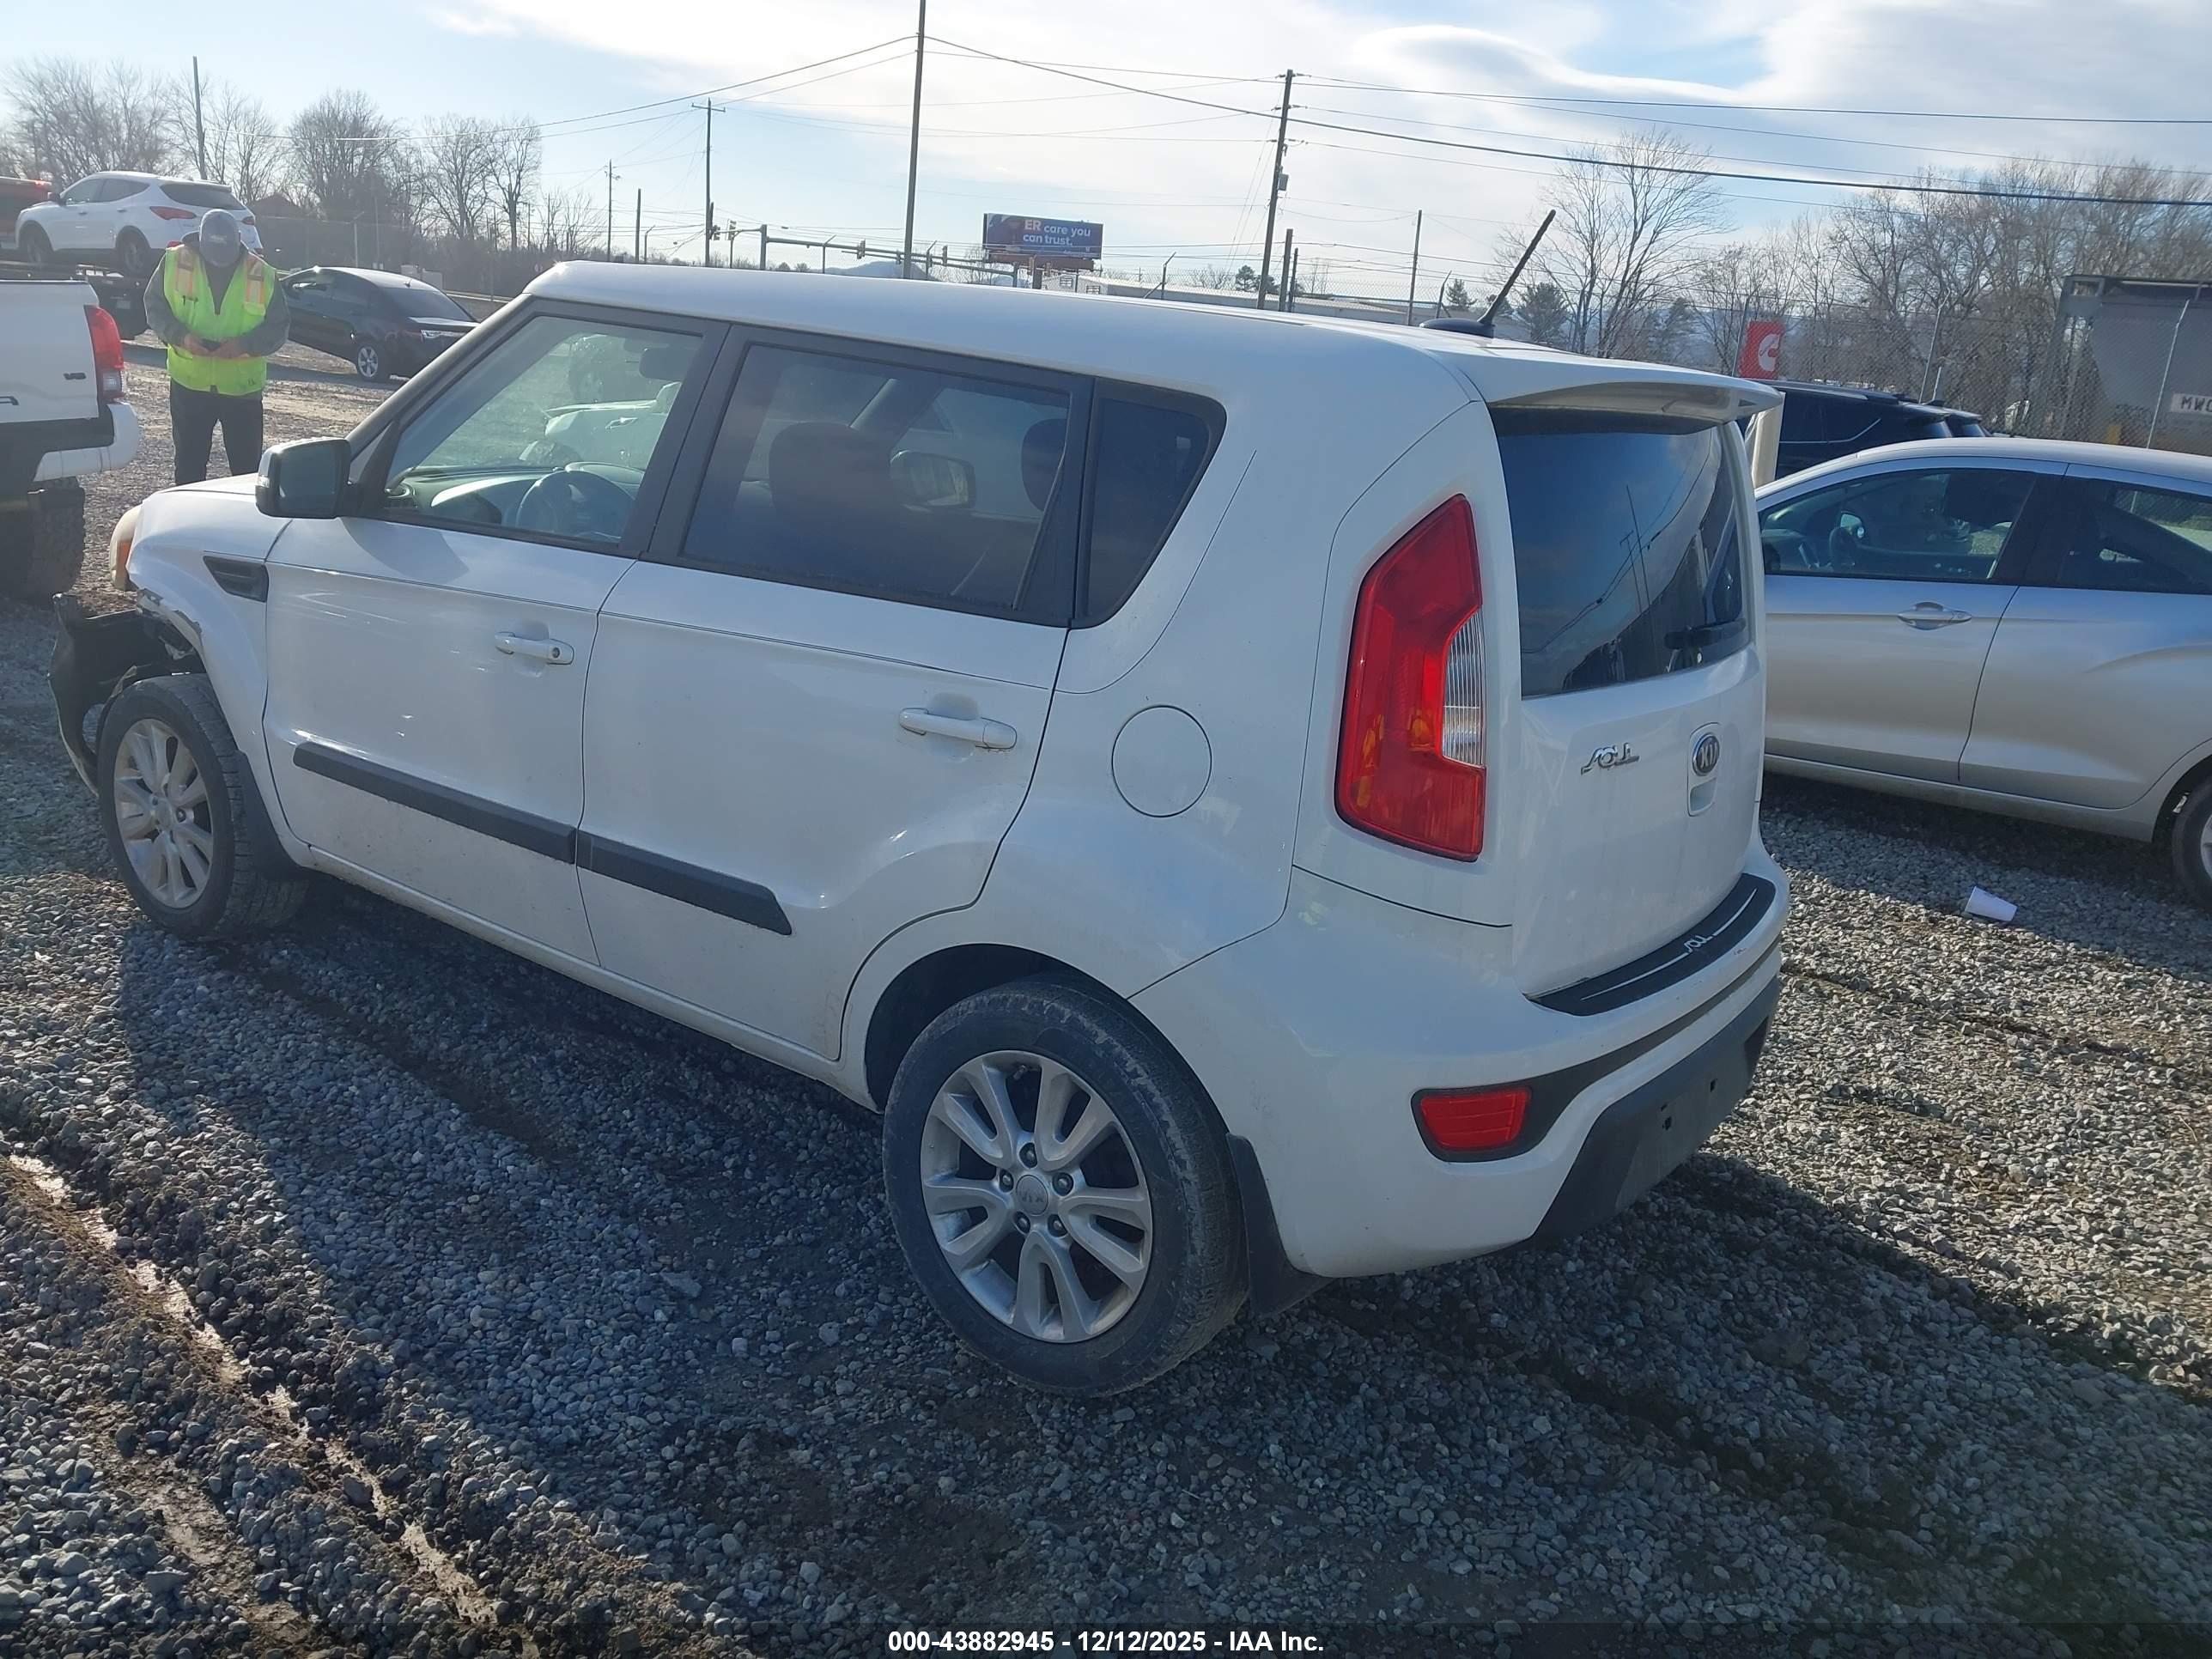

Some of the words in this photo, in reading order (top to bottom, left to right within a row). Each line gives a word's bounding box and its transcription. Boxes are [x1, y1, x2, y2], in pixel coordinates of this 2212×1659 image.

[1024, 219, 1042, 231] ER
[1044, 225, 1067, 234] care
[1071, 228, 1091, 238] you
[1023, 234, 1042, 244] can
[1044, 234, 1073, 246] trust.
[1699, 740, 1718, 769] KIA
